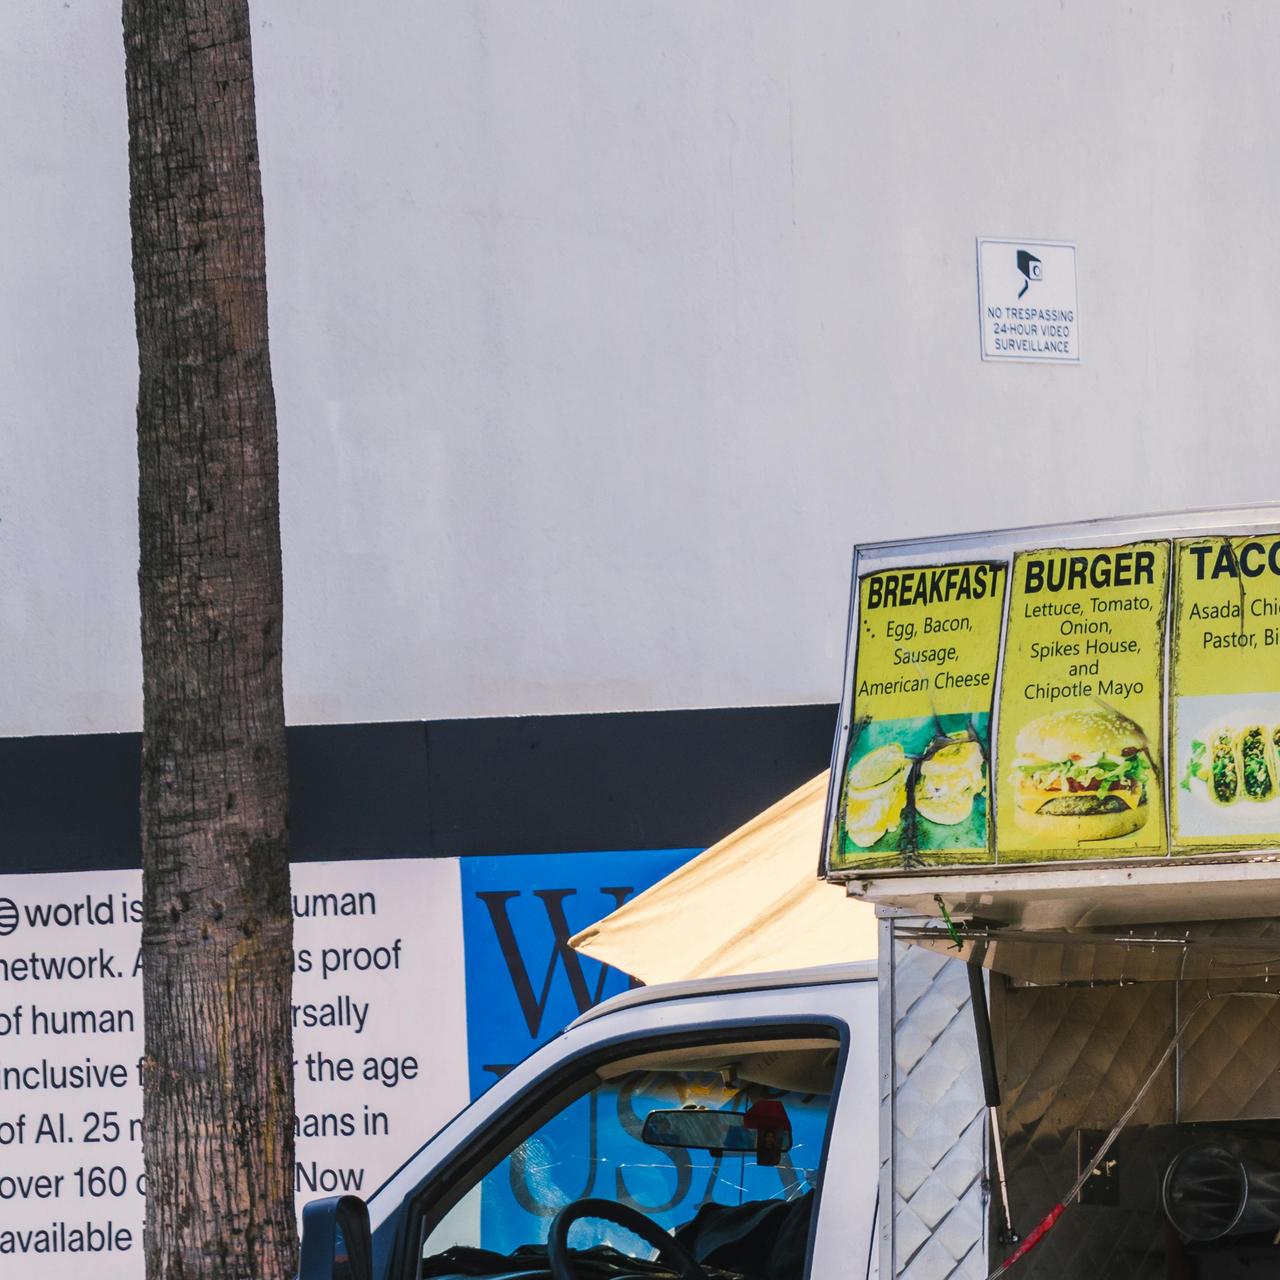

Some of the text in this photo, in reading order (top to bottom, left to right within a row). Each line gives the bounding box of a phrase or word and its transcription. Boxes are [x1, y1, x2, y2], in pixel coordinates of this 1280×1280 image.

[987, 307, 1074, 322] NO TRESPASSING
[993, 323, 1070, 338] 24-HOUR VIDEO
[995, 338, 1070, 353] SURVEILLANCE
[1024, 551, 1155, 594] BURGER
[867, 565, 1003, 610] BREAKFAST
[1024, 597, 1153, 618] Lettuce, Tomato,
[886, 617, 973, 641] Egg, Bacon,
[1060, 619, 1112, 635] Onion,
[1030, 639, 1141, 662] Spikes House,
[1203, 631, 1258, 649] Pastor,
[893, 647, 959, 666] Sausage,
[1069, 659, 1099, 676] and
[858, 671, 990, 697] American Cheese
[1024, 680, 1144, 702] Chipotle Mayo
[24, 892, 376, 927] world is uman
[322, 939, 402, 980] proof
[32, 1005, 134, 1035] human
[291, 995, 369, 1033] rsally
[1, 1058, 128, 1090] nclusive
[305, 1051, 354, 1081] the
[363, 1056, 418, 1088] age
[0, 1114, 25, 1144] of
[35, 1112, 73, 1144] AI.
[83, 1111, 120, 1143] 25
[364, 1105, 389, 1136] in
[0, 1175, 64, 1199] over
[74, 1166, 127, 1198] 160
[295, 1161, 364, 1193] Now
[0, 1221, 132, 1253] available
